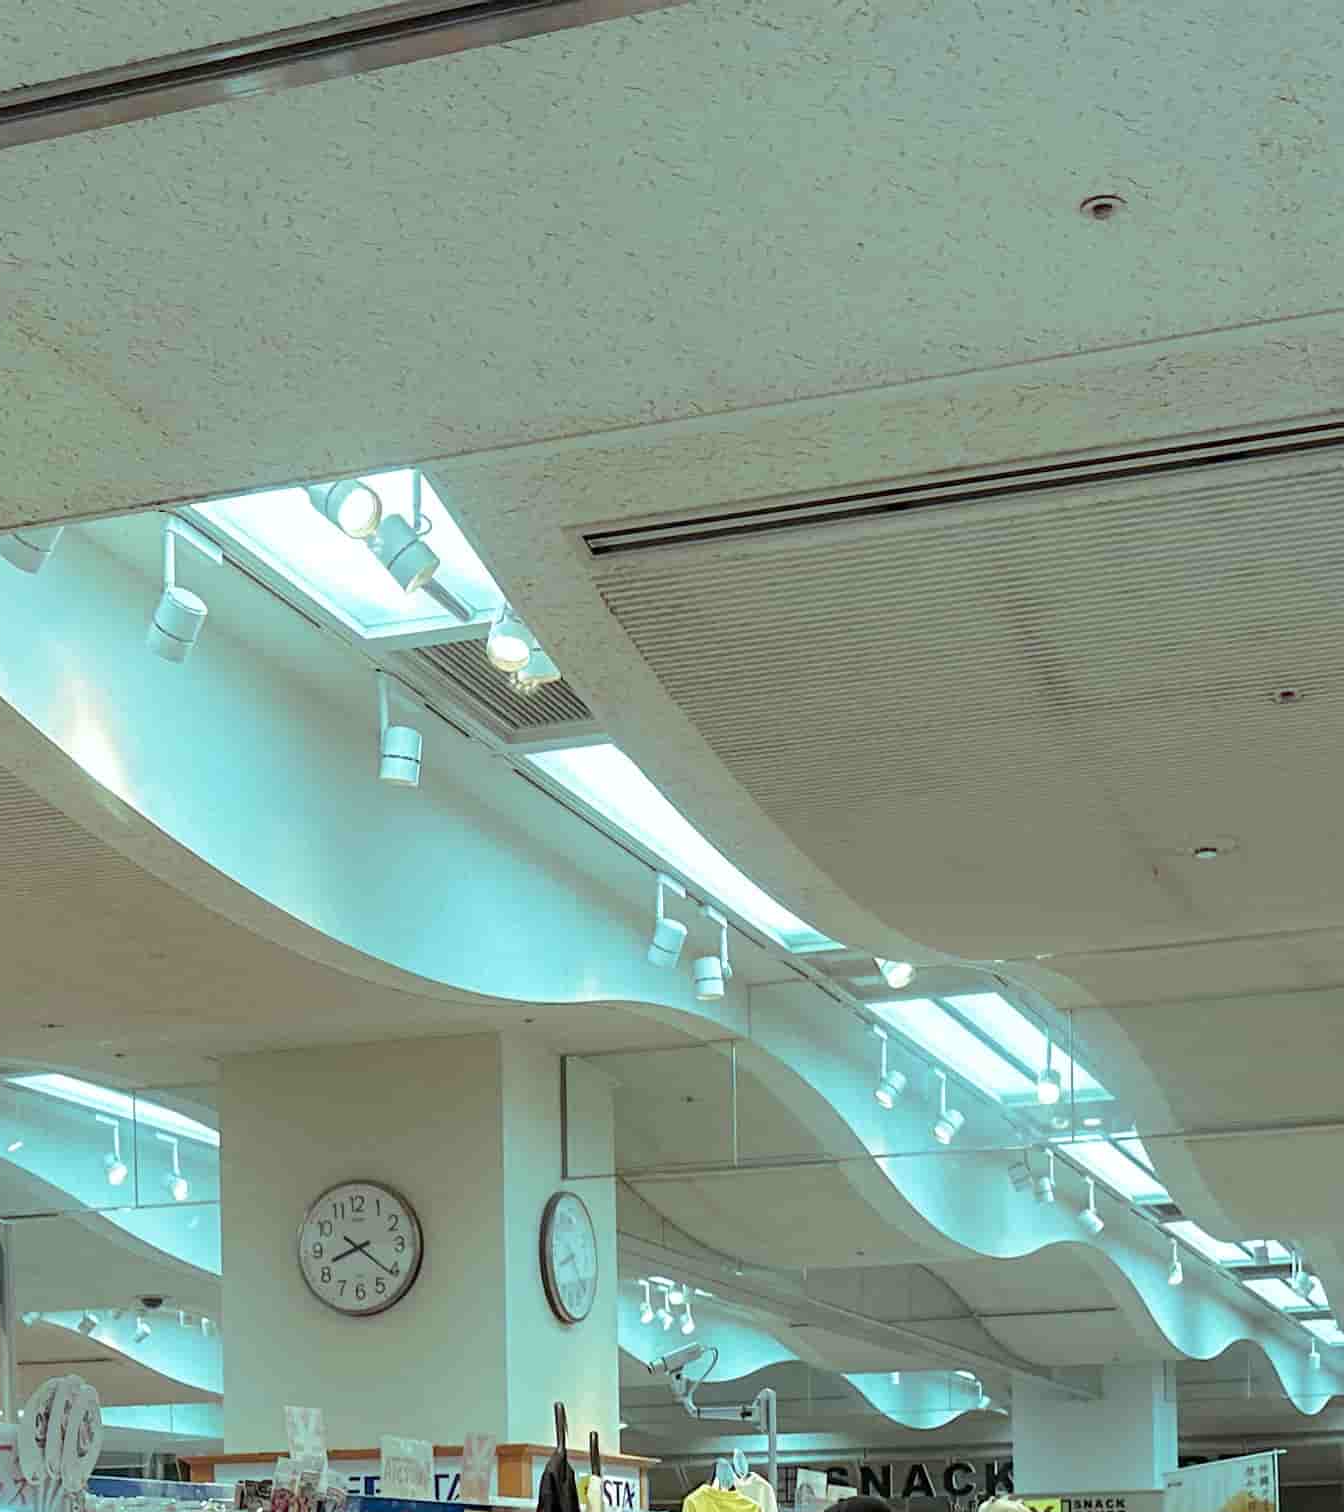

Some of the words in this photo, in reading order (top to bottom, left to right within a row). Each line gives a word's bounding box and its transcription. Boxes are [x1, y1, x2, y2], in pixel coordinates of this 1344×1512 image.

[333, 1203, 345, 1220] 11
[350, 1196, 365, 1213] 12
[318, 1220, 333, 1237] 10
[388, 1215, 400, 1231] 2
[312, 1244, 323, 1259] 9
[394, 1236, 405, 1253] 3
[321, 1267, 332, 1283] 8
[338, 1280, 347, 1296] 7
[356, 1283, 366, 1299] 6
[376, 1277, 386, 1294] 5
[1073, 1499, 1126, 1509] SNACK
